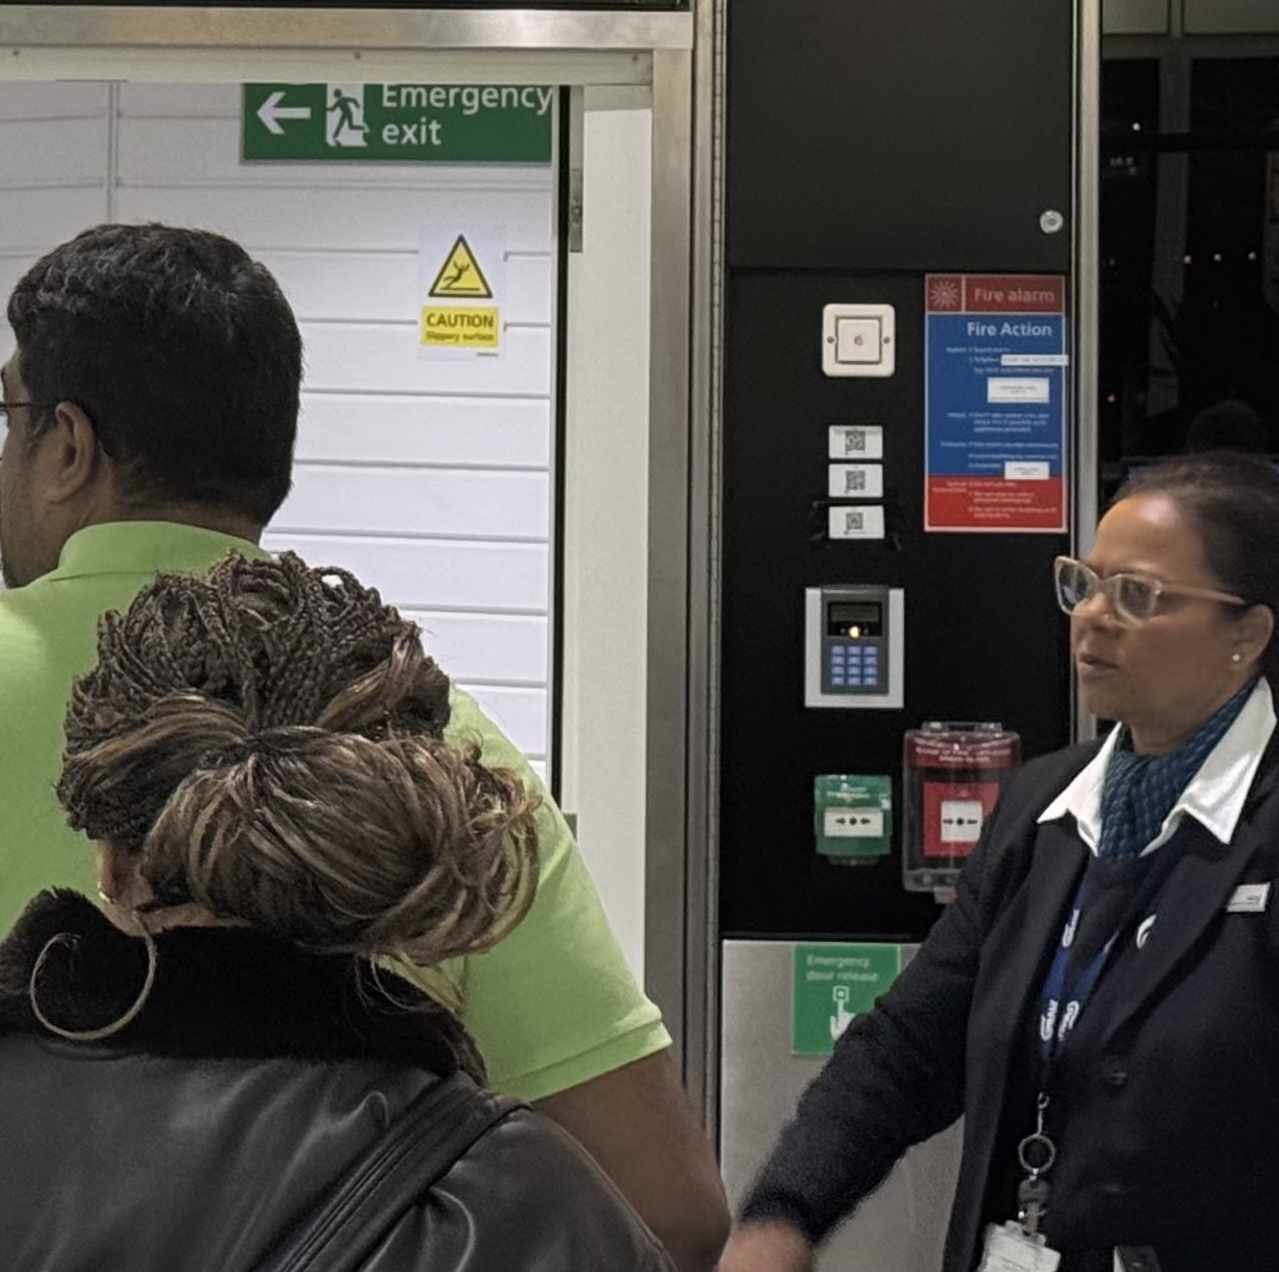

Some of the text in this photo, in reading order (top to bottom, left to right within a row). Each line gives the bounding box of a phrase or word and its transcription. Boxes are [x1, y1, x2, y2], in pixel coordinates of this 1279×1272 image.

[382, 84, 553, 116] Emergency
[382, 117, 442, 146] exit
[974, 287, 1055, 302] Fire alarm
[426, 312, 494, 328] CAUTION
[967, 321, 1053, 337] Fire Action
[806, 954, 871, 969] Emergency
[806, 970, 879, 983] door release
